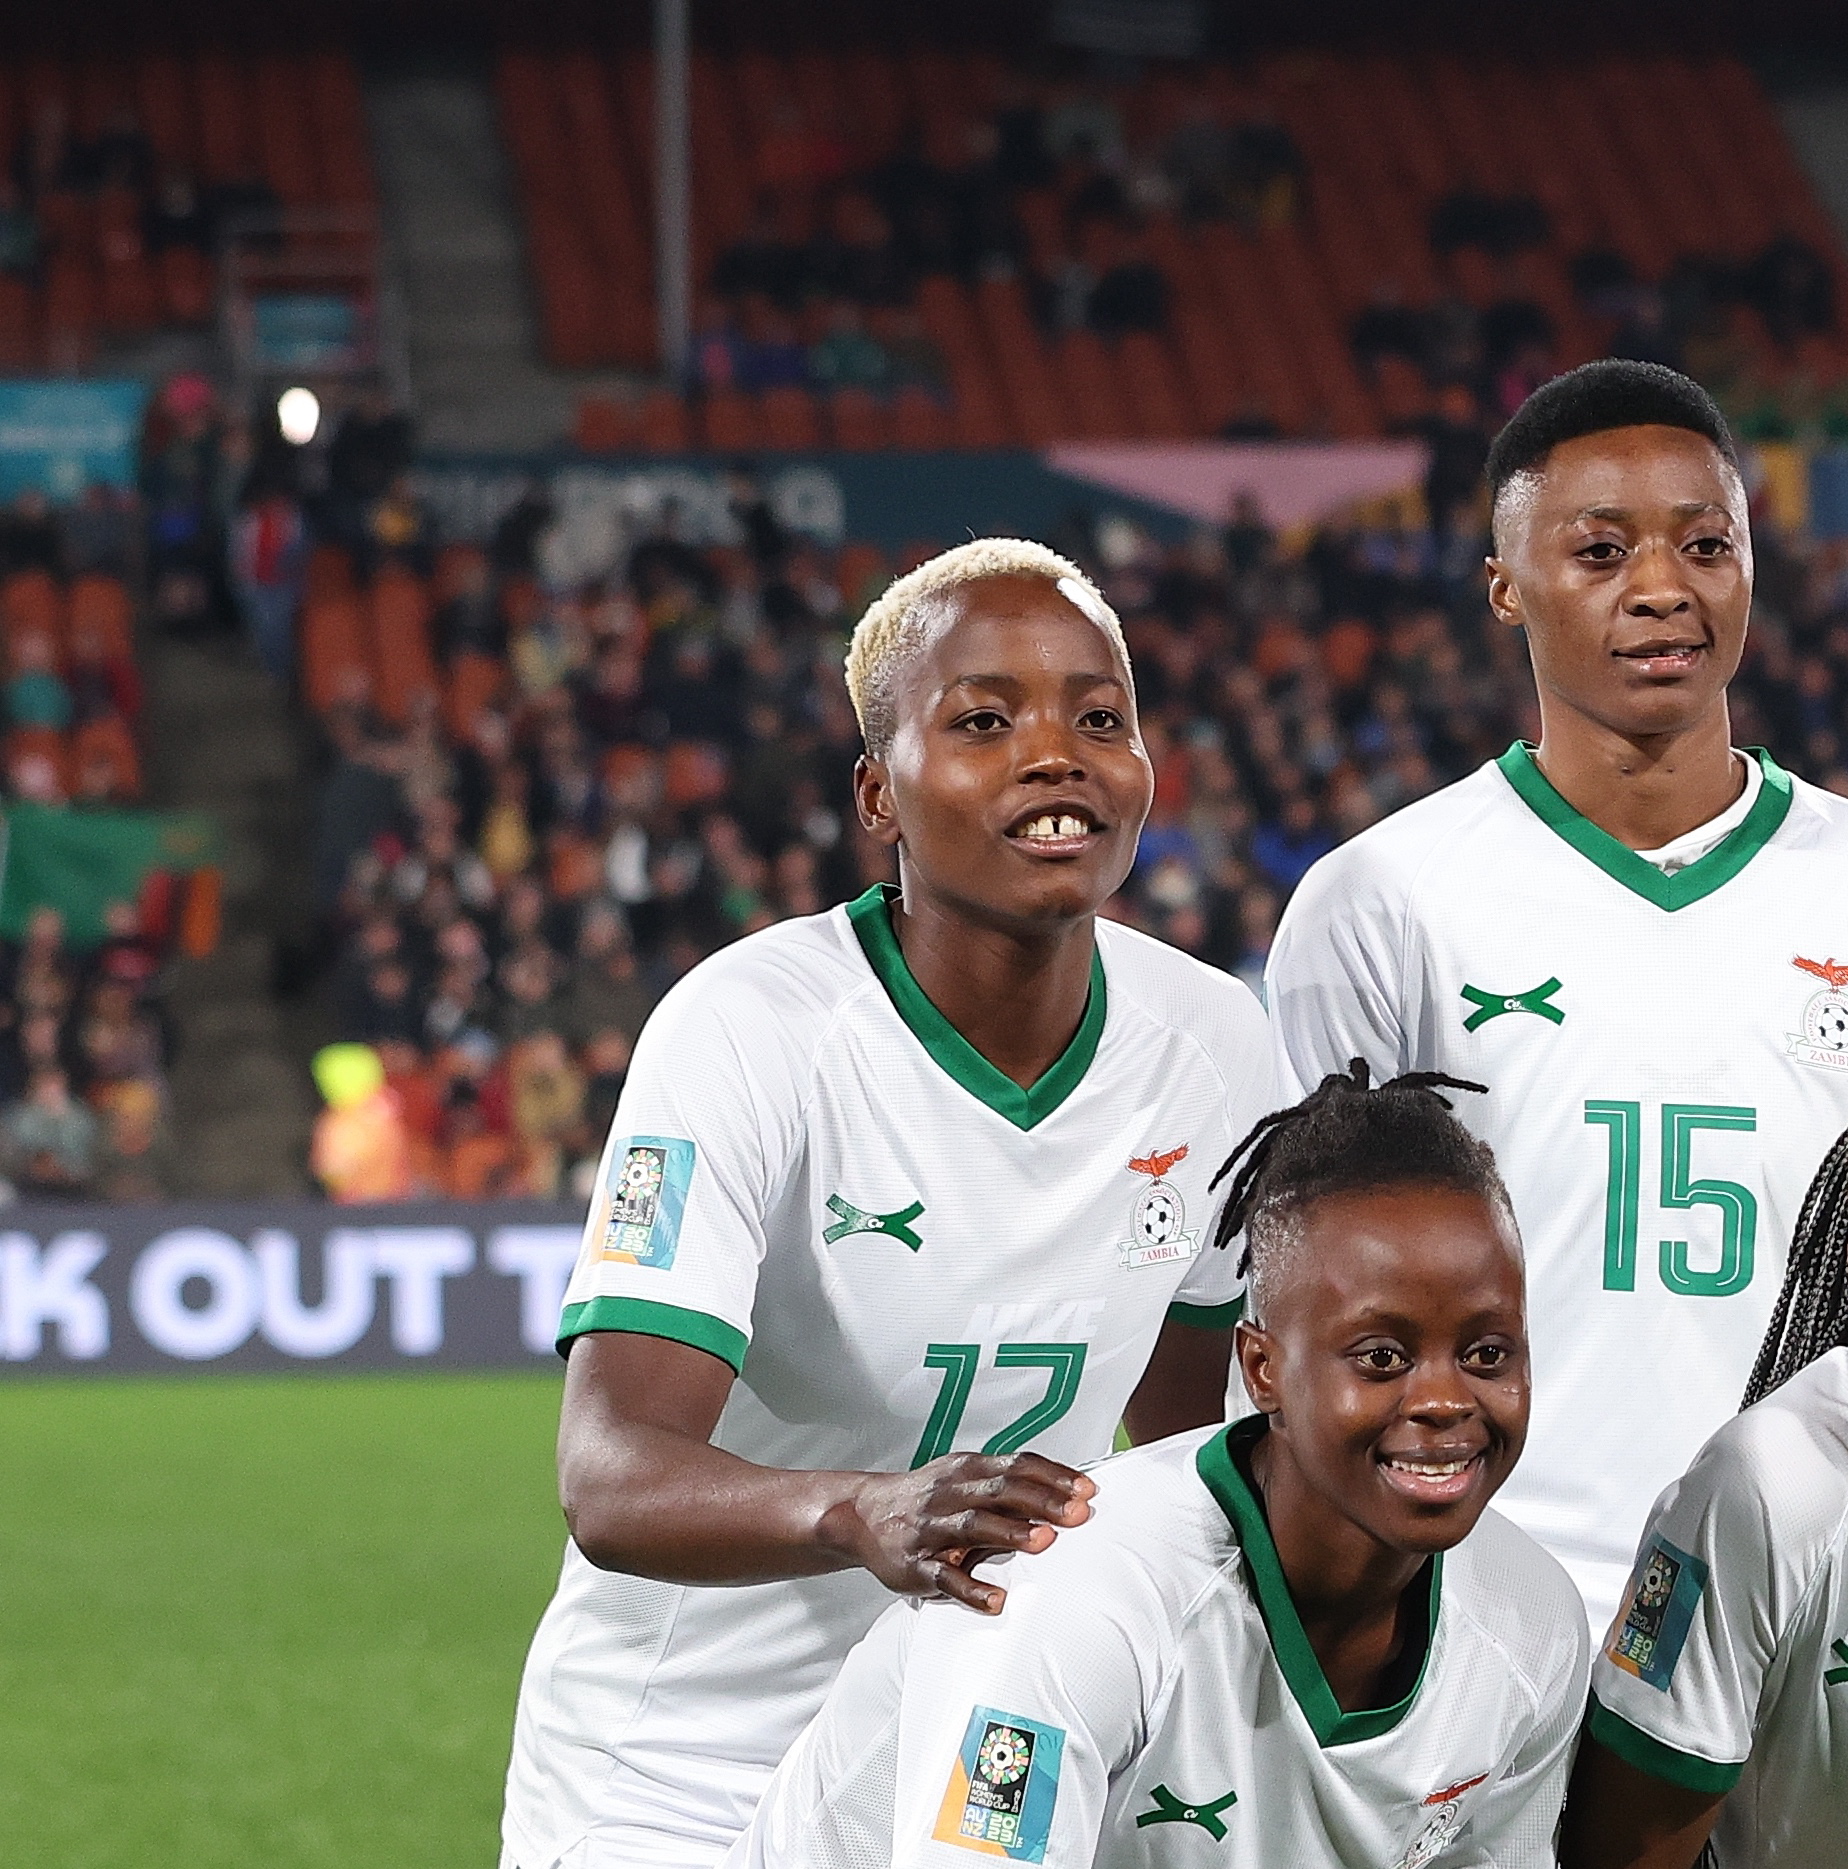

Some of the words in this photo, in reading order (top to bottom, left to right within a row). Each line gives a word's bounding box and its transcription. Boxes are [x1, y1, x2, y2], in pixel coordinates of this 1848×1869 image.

[1584, 1100, 1757, 1297] 15
[622, 1226, 647, 1241] 20
[620, 1239, 645, 1251] 23
[1140, 1246, 1180, 1264] ZAMBIA
[131, 1226, 477, 1360] OUT
[909, 1342, 1088, 1472] 17
[972, 1780, 989, 1791] FIFA
[970, 1789, 1004, 1803] WOMEN'S
[970, 1797, 994, 1808] WORLD
[993, 1799, 1011, 1810] CUP
[964, 1806, 988, 1823] AU
[989, 1811, 1016, 1830] 20
[962, 1821, 984, 1836] NZ
[987, 1826, 1015, 1842] 23
